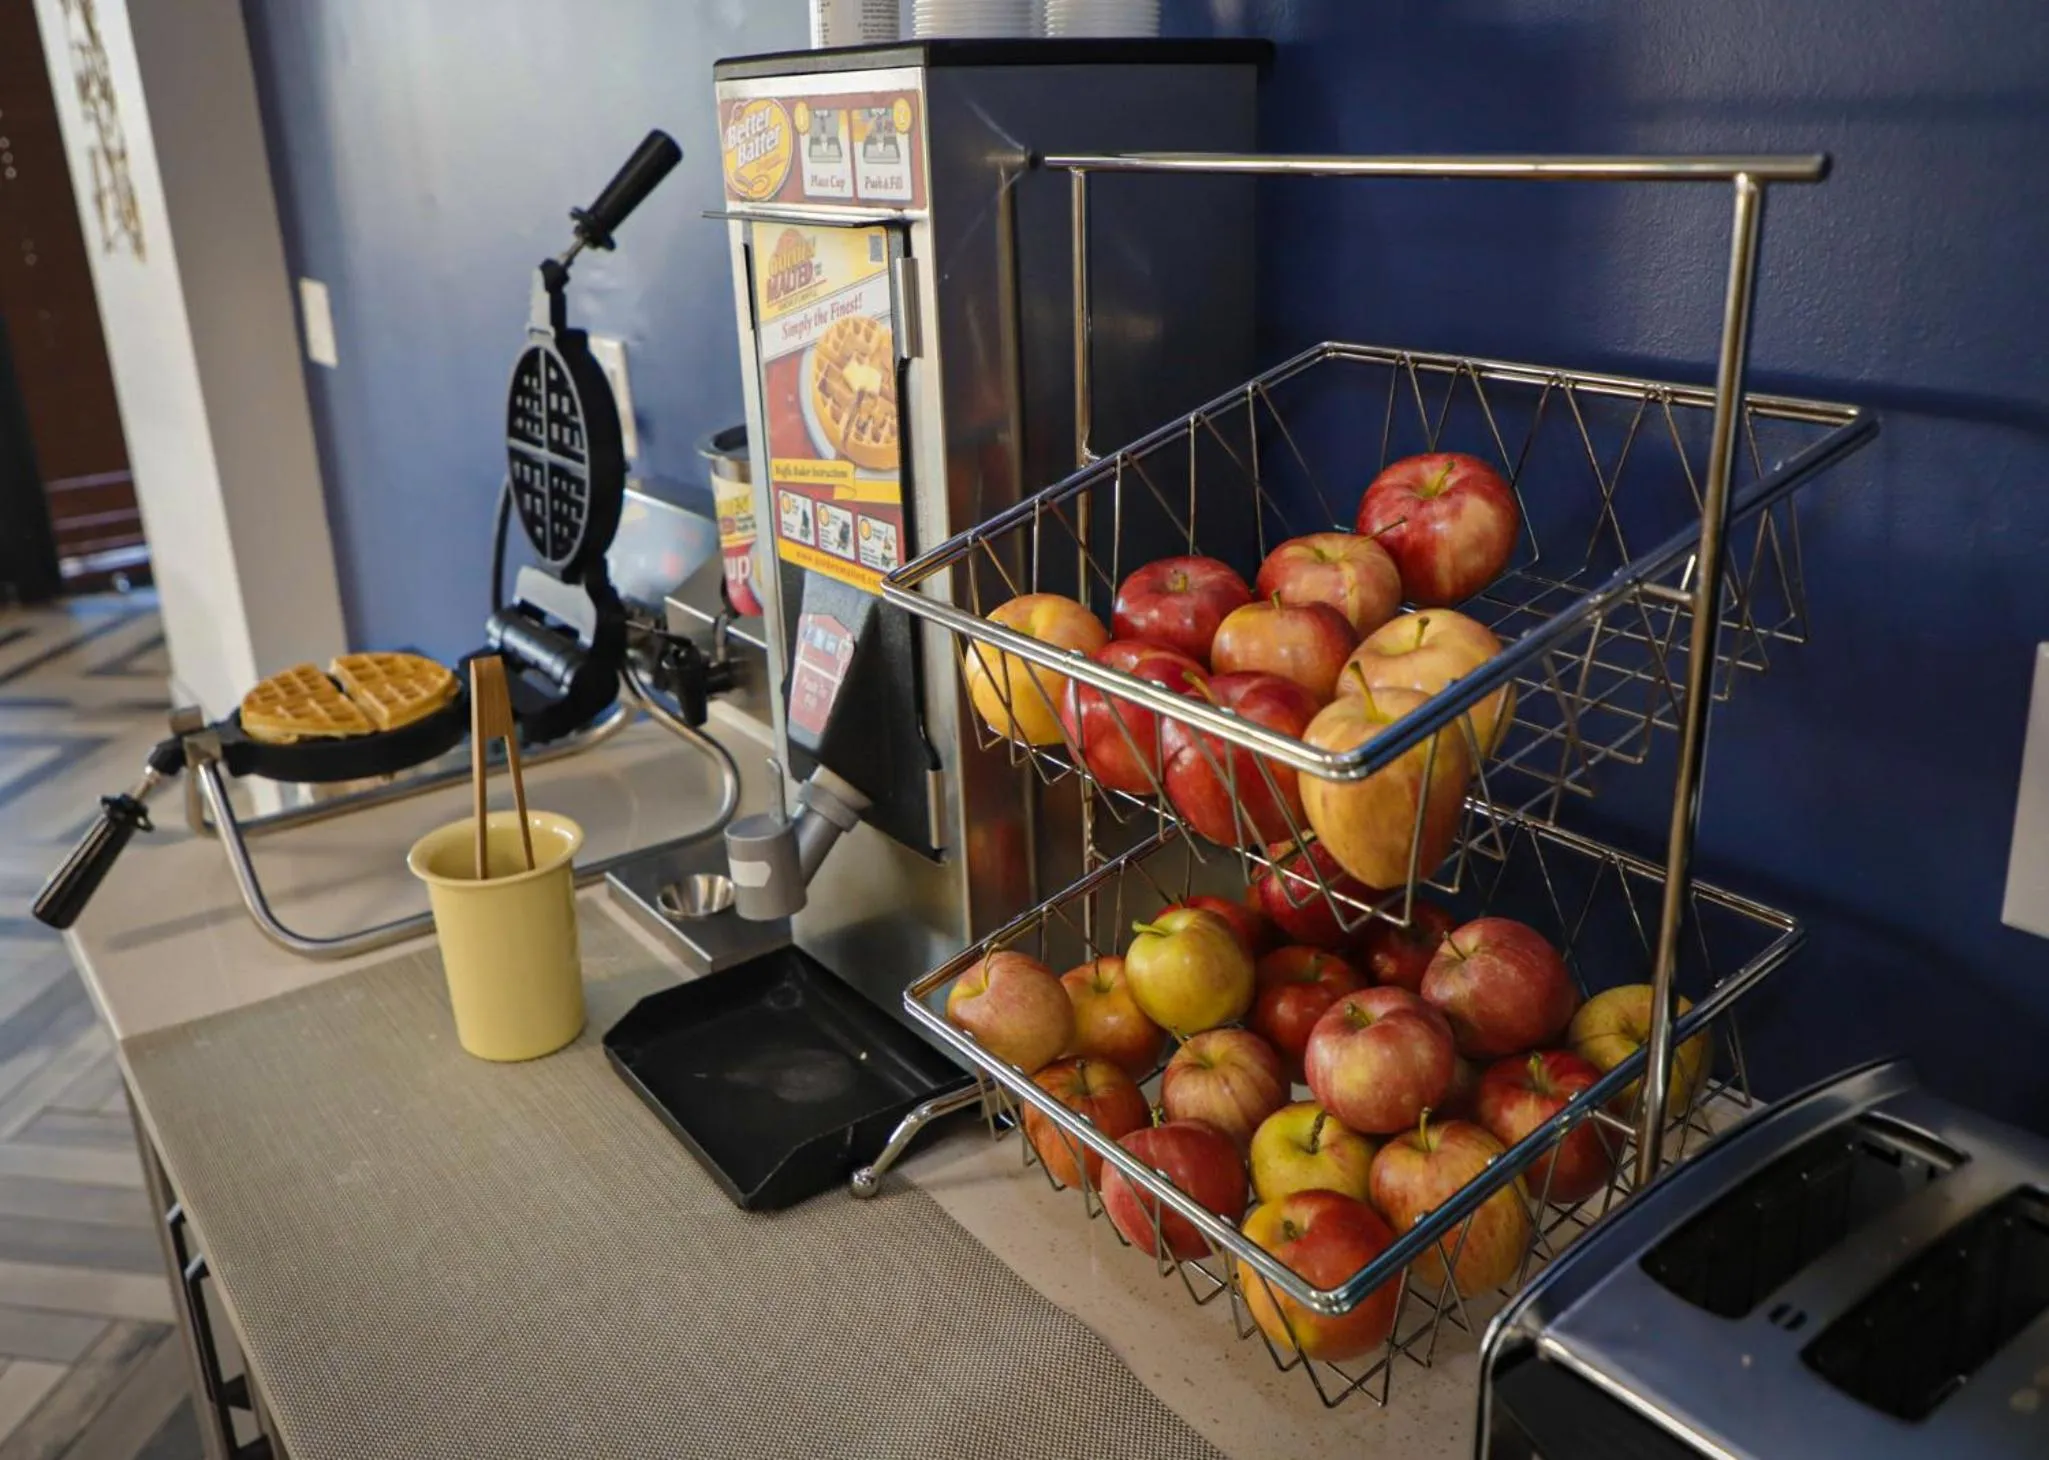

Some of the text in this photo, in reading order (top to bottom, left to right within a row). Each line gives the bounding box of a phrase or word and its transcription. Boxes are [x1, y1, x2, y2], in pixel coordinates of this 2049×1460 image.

[727, 106, 771, 147] Better
[736, 125, 781, 168] Batter
[782, 313, 812, 340] Simply
[813, 306, 829, 327] the
[830, 291, 864, 320] Finest!
